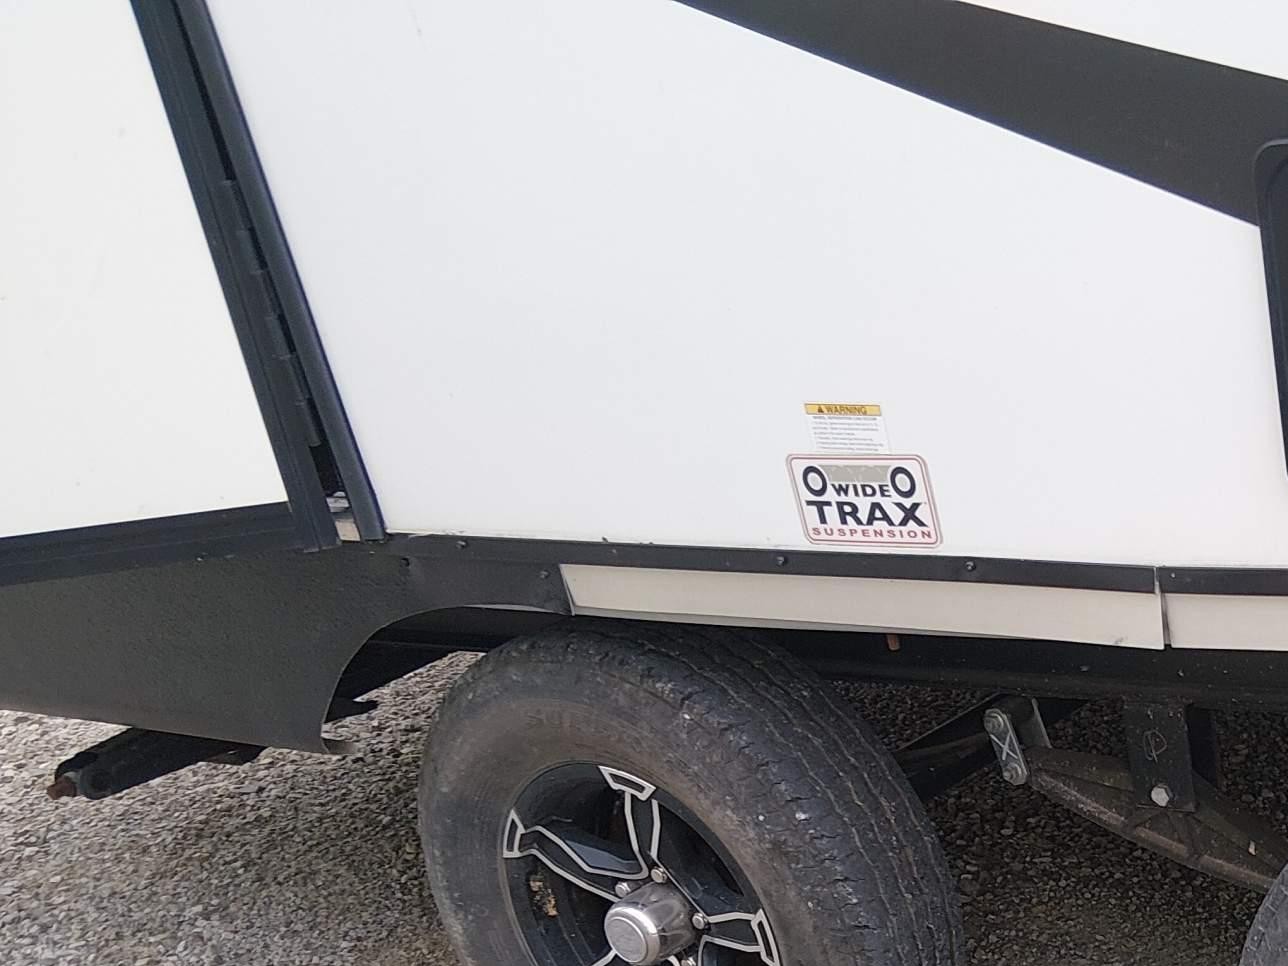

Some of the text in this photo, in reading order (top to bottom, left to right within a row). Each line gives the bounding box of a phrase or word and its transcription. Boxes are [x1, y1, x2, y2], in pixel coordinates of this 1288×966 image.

[825, 405, 868, 415] WARNING
[831, 483, 892, 498] WIDE
[805, 500, 929, 528] TRAX
[812, 527, 933, 539] SUSPENSION
